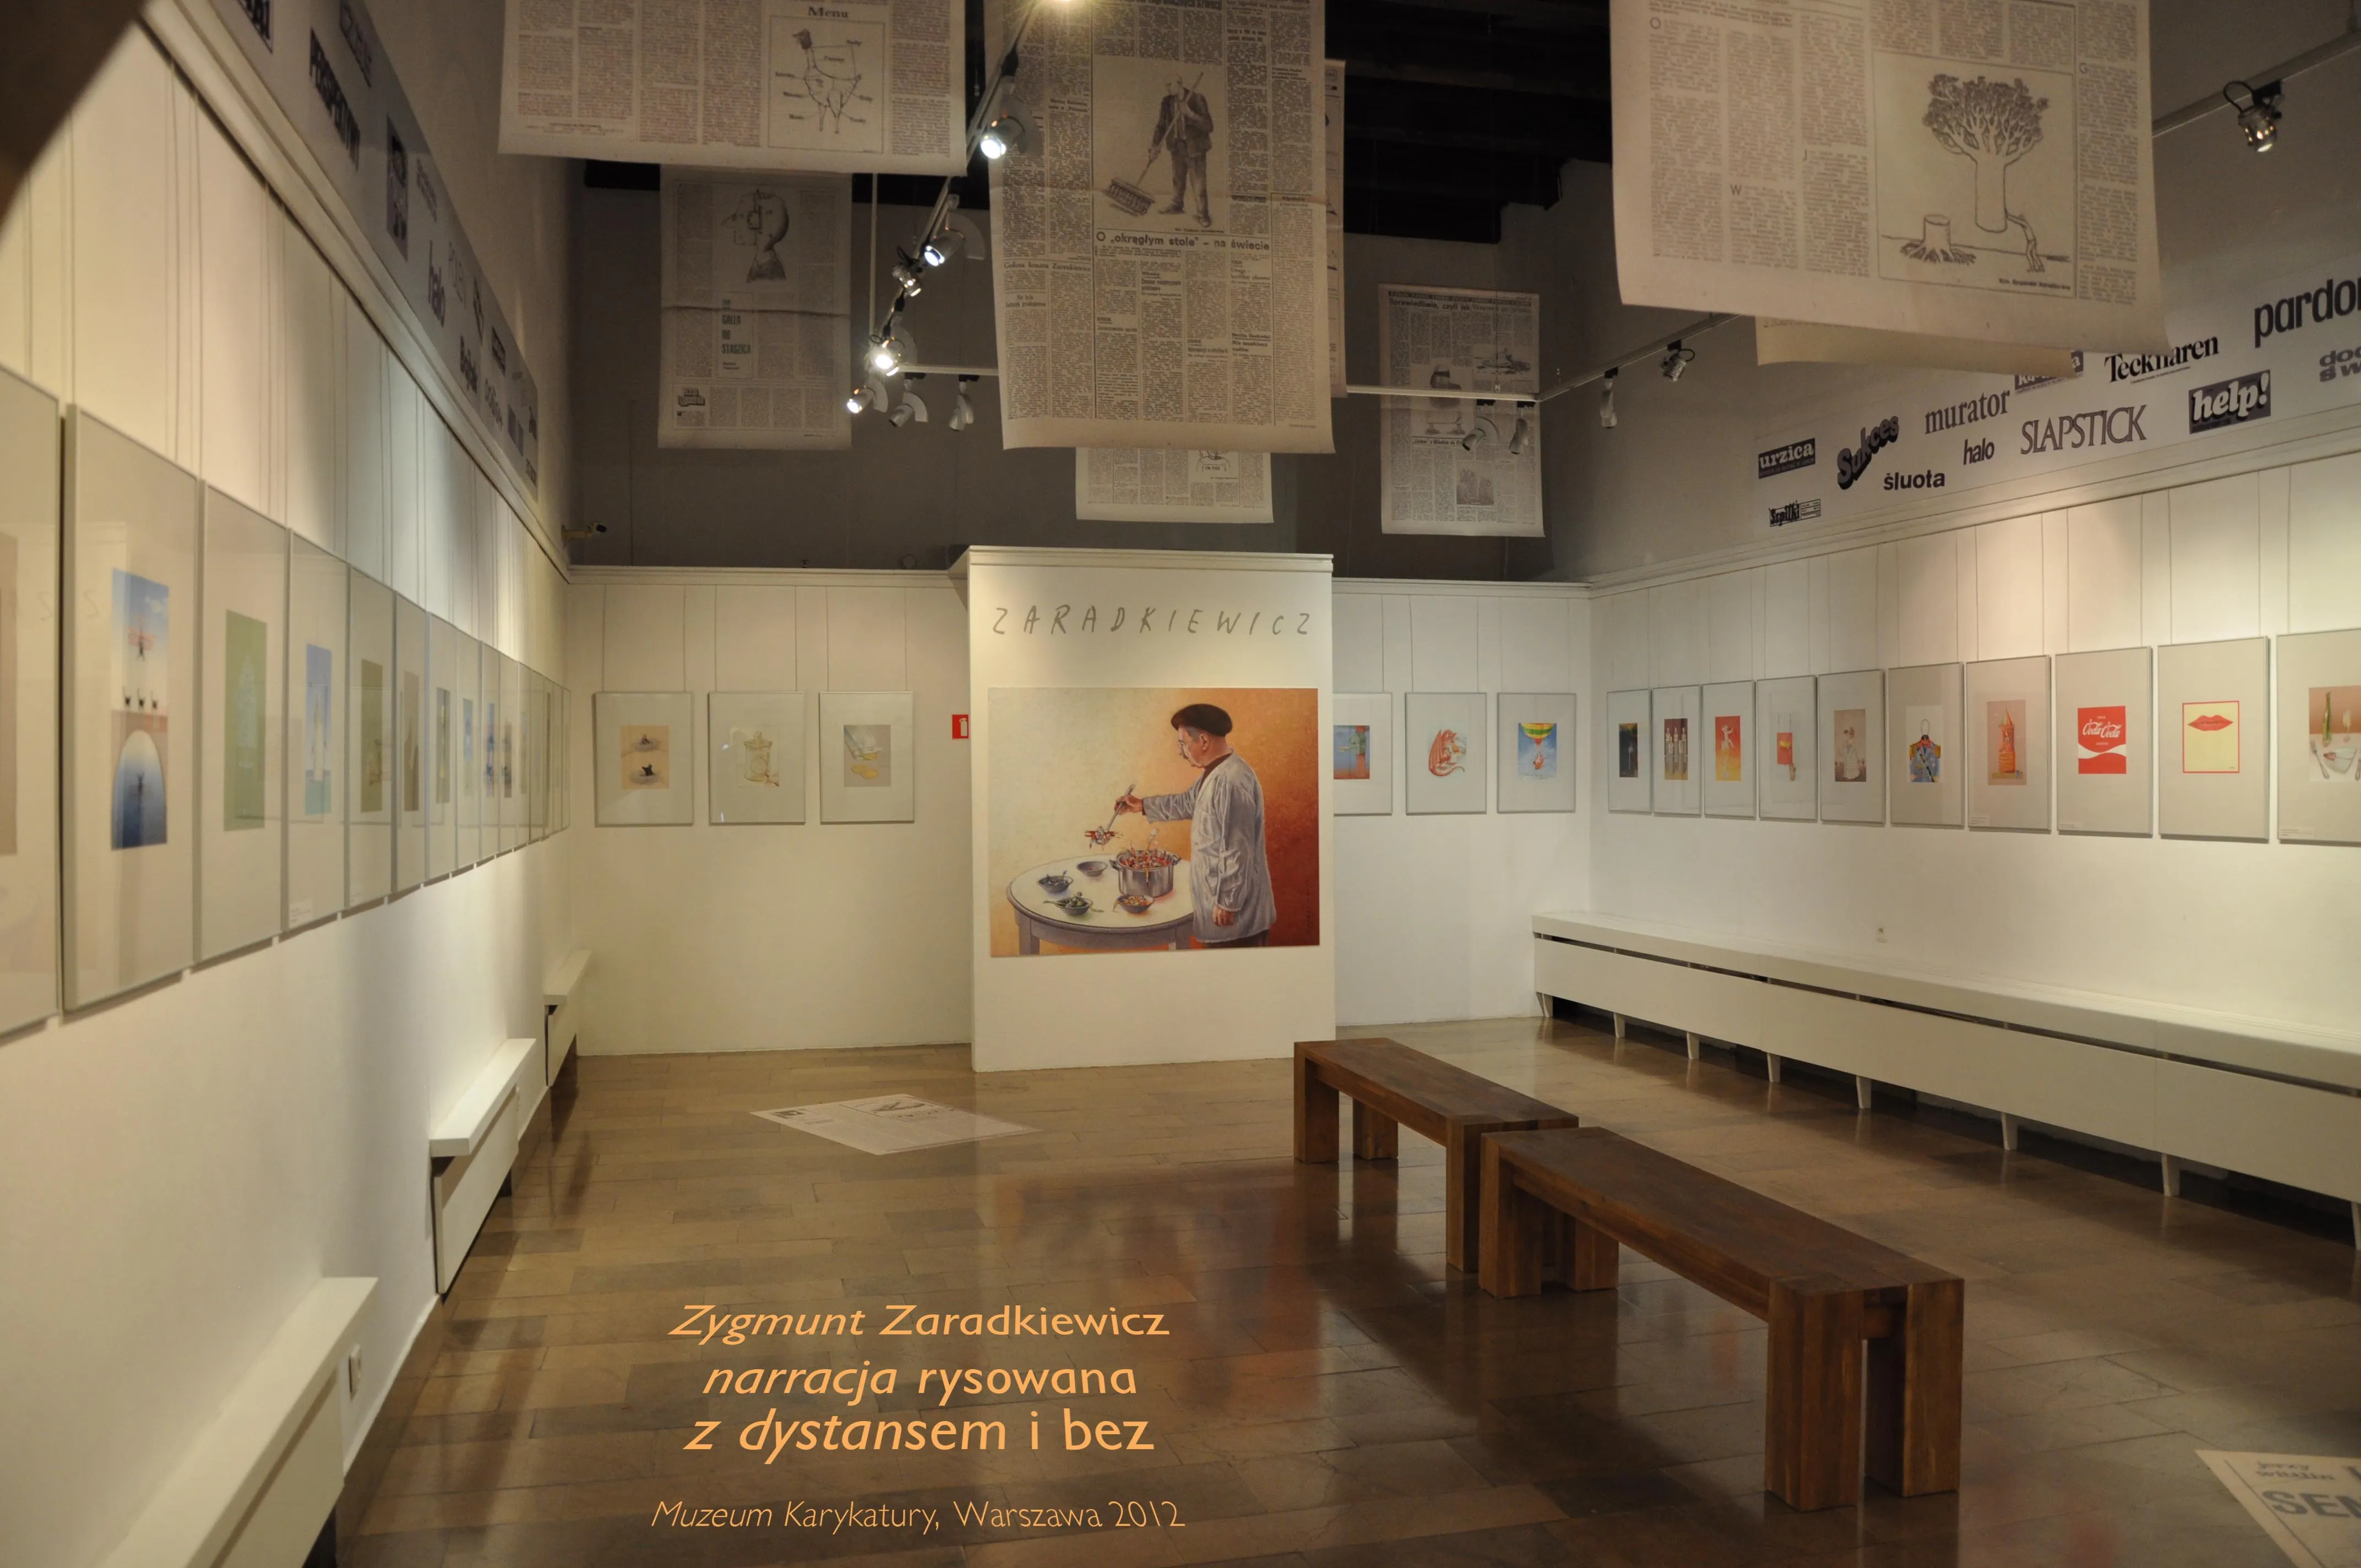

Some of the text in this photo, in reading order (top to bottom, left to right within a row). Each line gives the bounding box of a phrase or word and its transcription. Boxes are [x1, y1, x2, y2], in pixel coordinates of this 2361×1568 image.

[808, 7, 849, 18] Menu
[1096, 231, 1106, 242] O
[2254, 275, 2361, 349] pardo
[2103, 335, 2219, 383] Tecknaren
[1925, 390, 2010, 435] murator
[2190, 369, 2270, 424] help!
[1963, 437, 1995, 465] halo
[2021, 404, 2147, 455] SLAPSTICK
[1759, 443, 1814, 469] urzica
[1837, 416, 1900, 490] Sukces
[992, 604, 1310, 636] ZARADKIEWICZ
